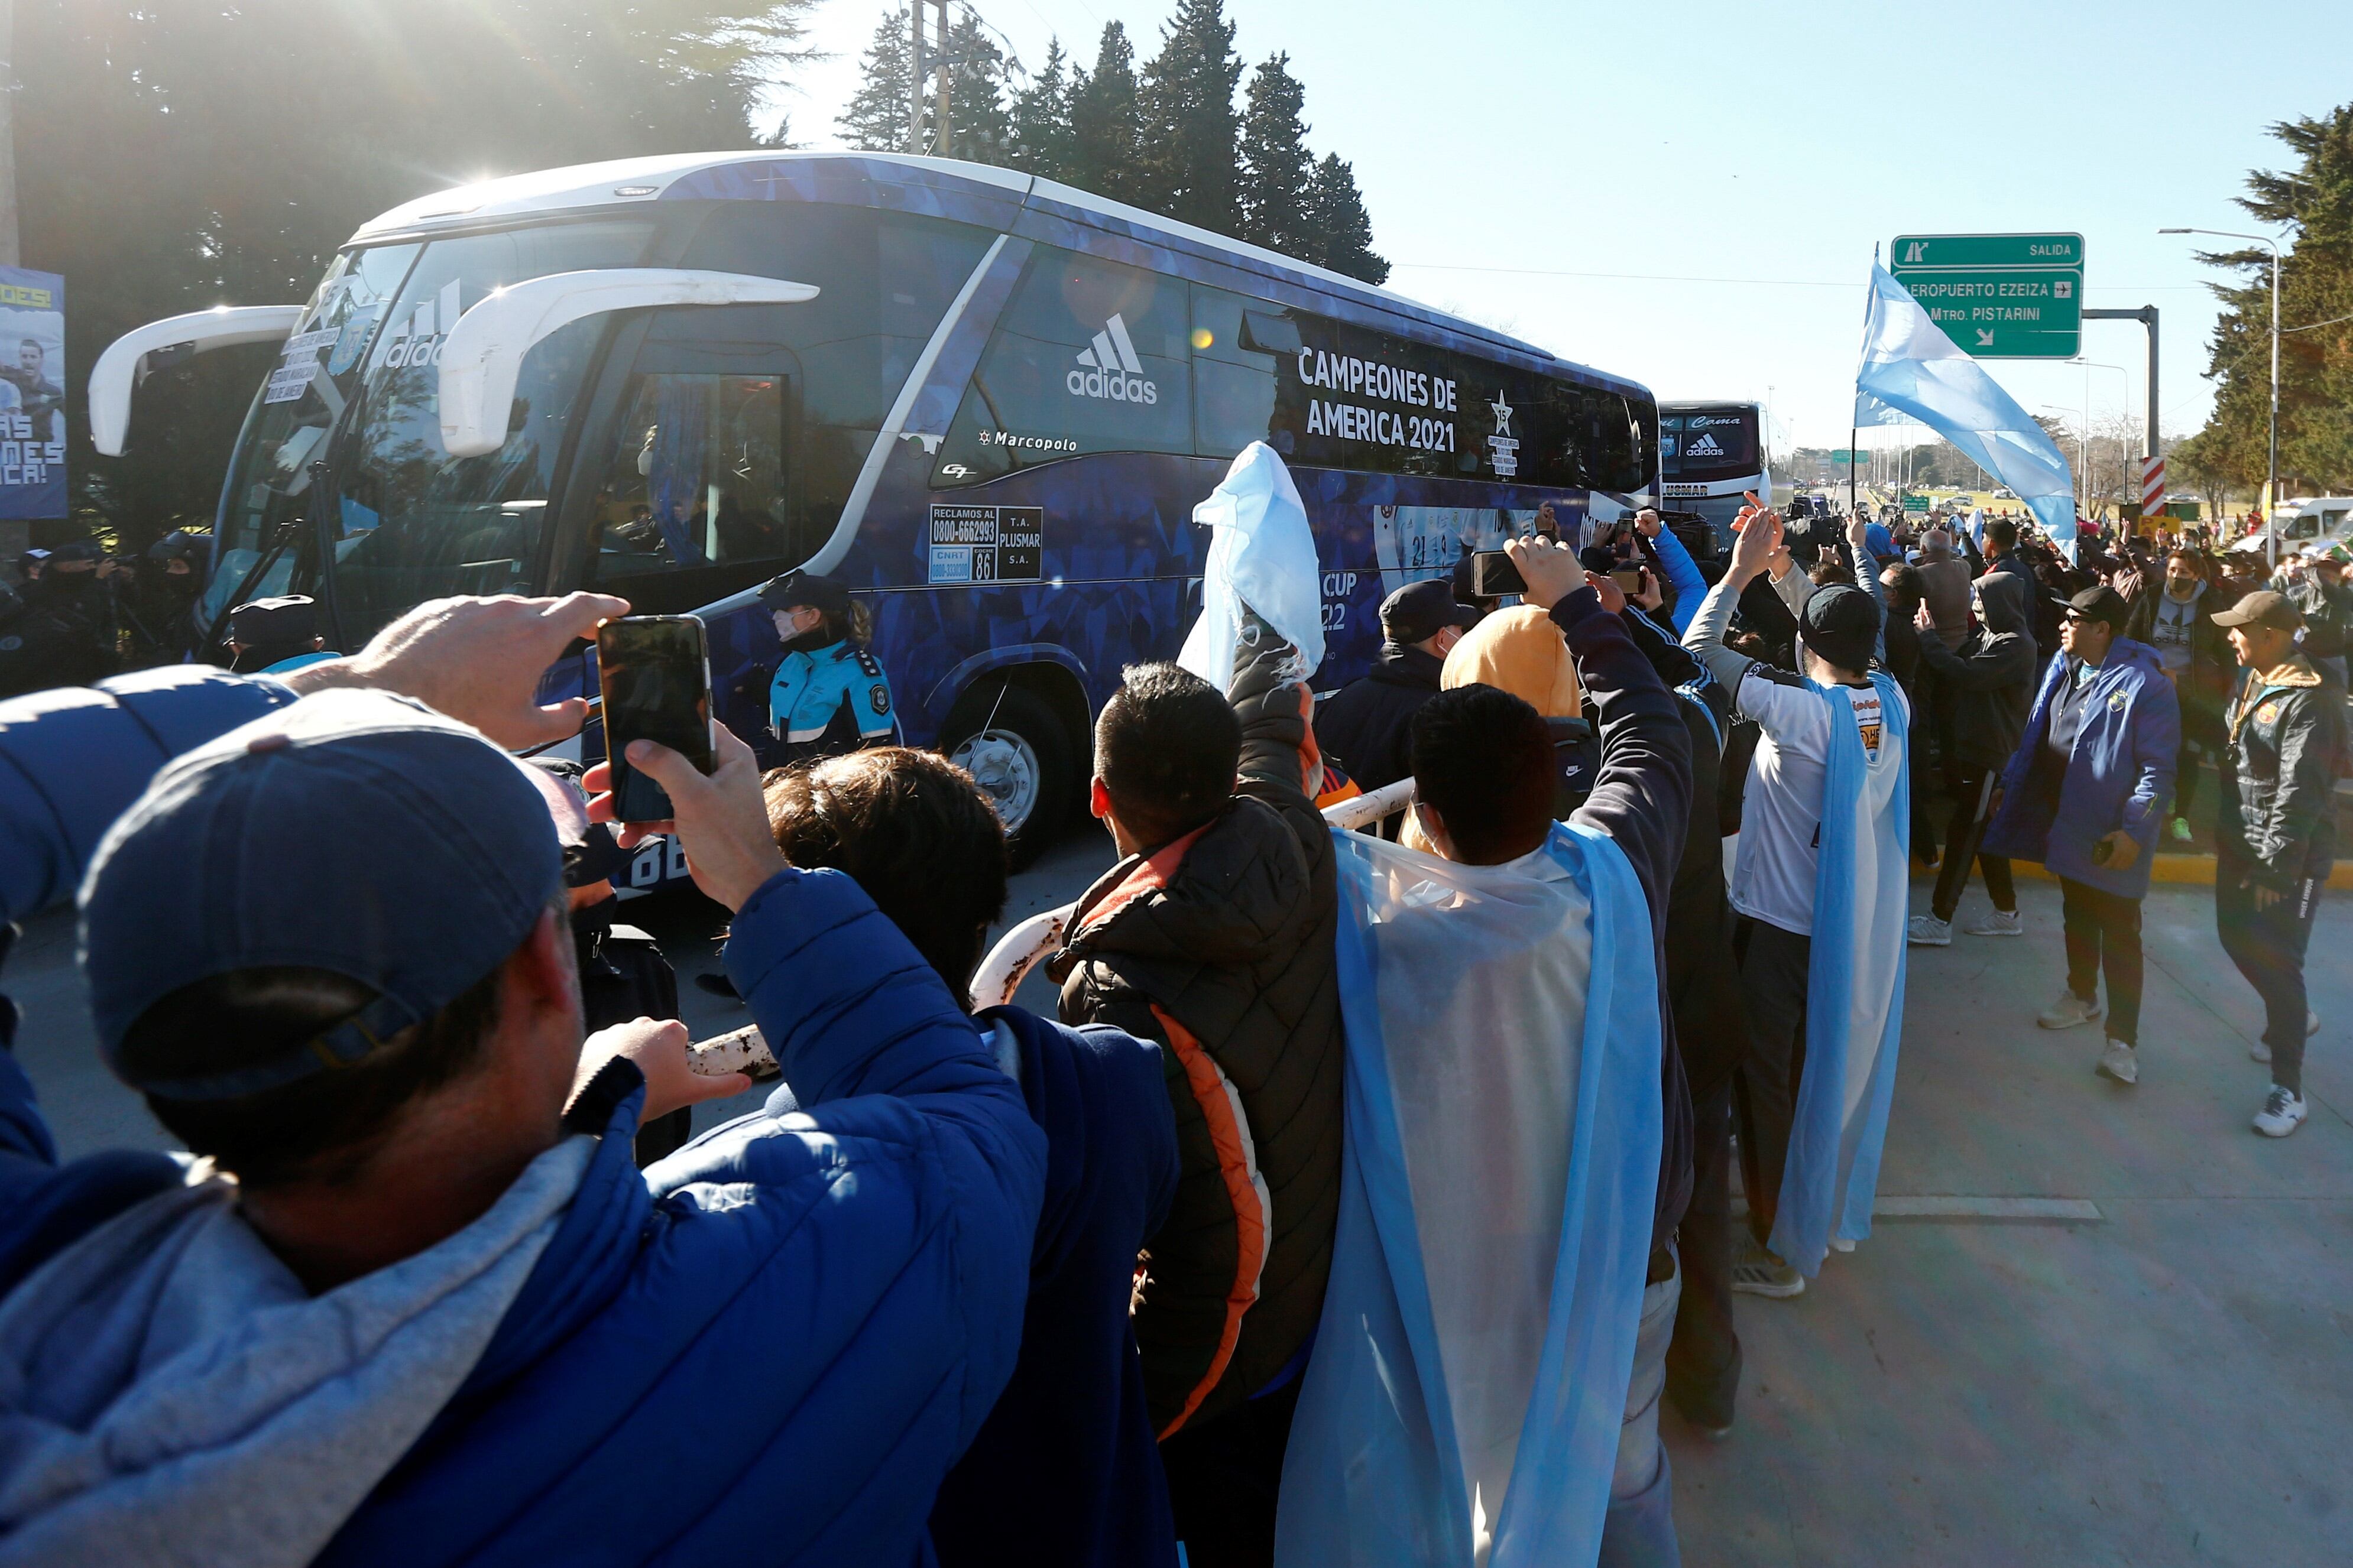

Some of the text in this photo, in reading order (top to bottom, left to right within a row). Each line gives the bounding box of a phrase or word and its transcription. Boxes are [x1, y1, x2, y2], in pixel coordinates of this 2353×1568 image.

[2029, 244, 2072, 256] SALIDA
[1999, 283, 2049, 296] EZEIZA
[1972, 307, 2040, 320] PISTARINI
[1067, 366, 1158, 405] adidas
[1298, 346, 1457, 413] CAMPEONES DE
[1498, 409, 1506, 422] 15
[1691, 415, 1741, 428] Cama
[1306, 399, 1454, 453] AMERICA 2021
[994, 431, 1077, 452] Marcopolo
[1686, 447, 1724, 456] adidas
[934, 509, 995, 519] RECLAMOS AL
[1010, 518, 1030, 527] T.A.
[934, 520, 994, 542] 0800-6662993
[1000, 533, 1041, 547] PLUSMAR
[1009, 555, 1029, 564] S.A.
[976, 553, 990, 580] 86
[1323, 572, 1357, 597] CUP
